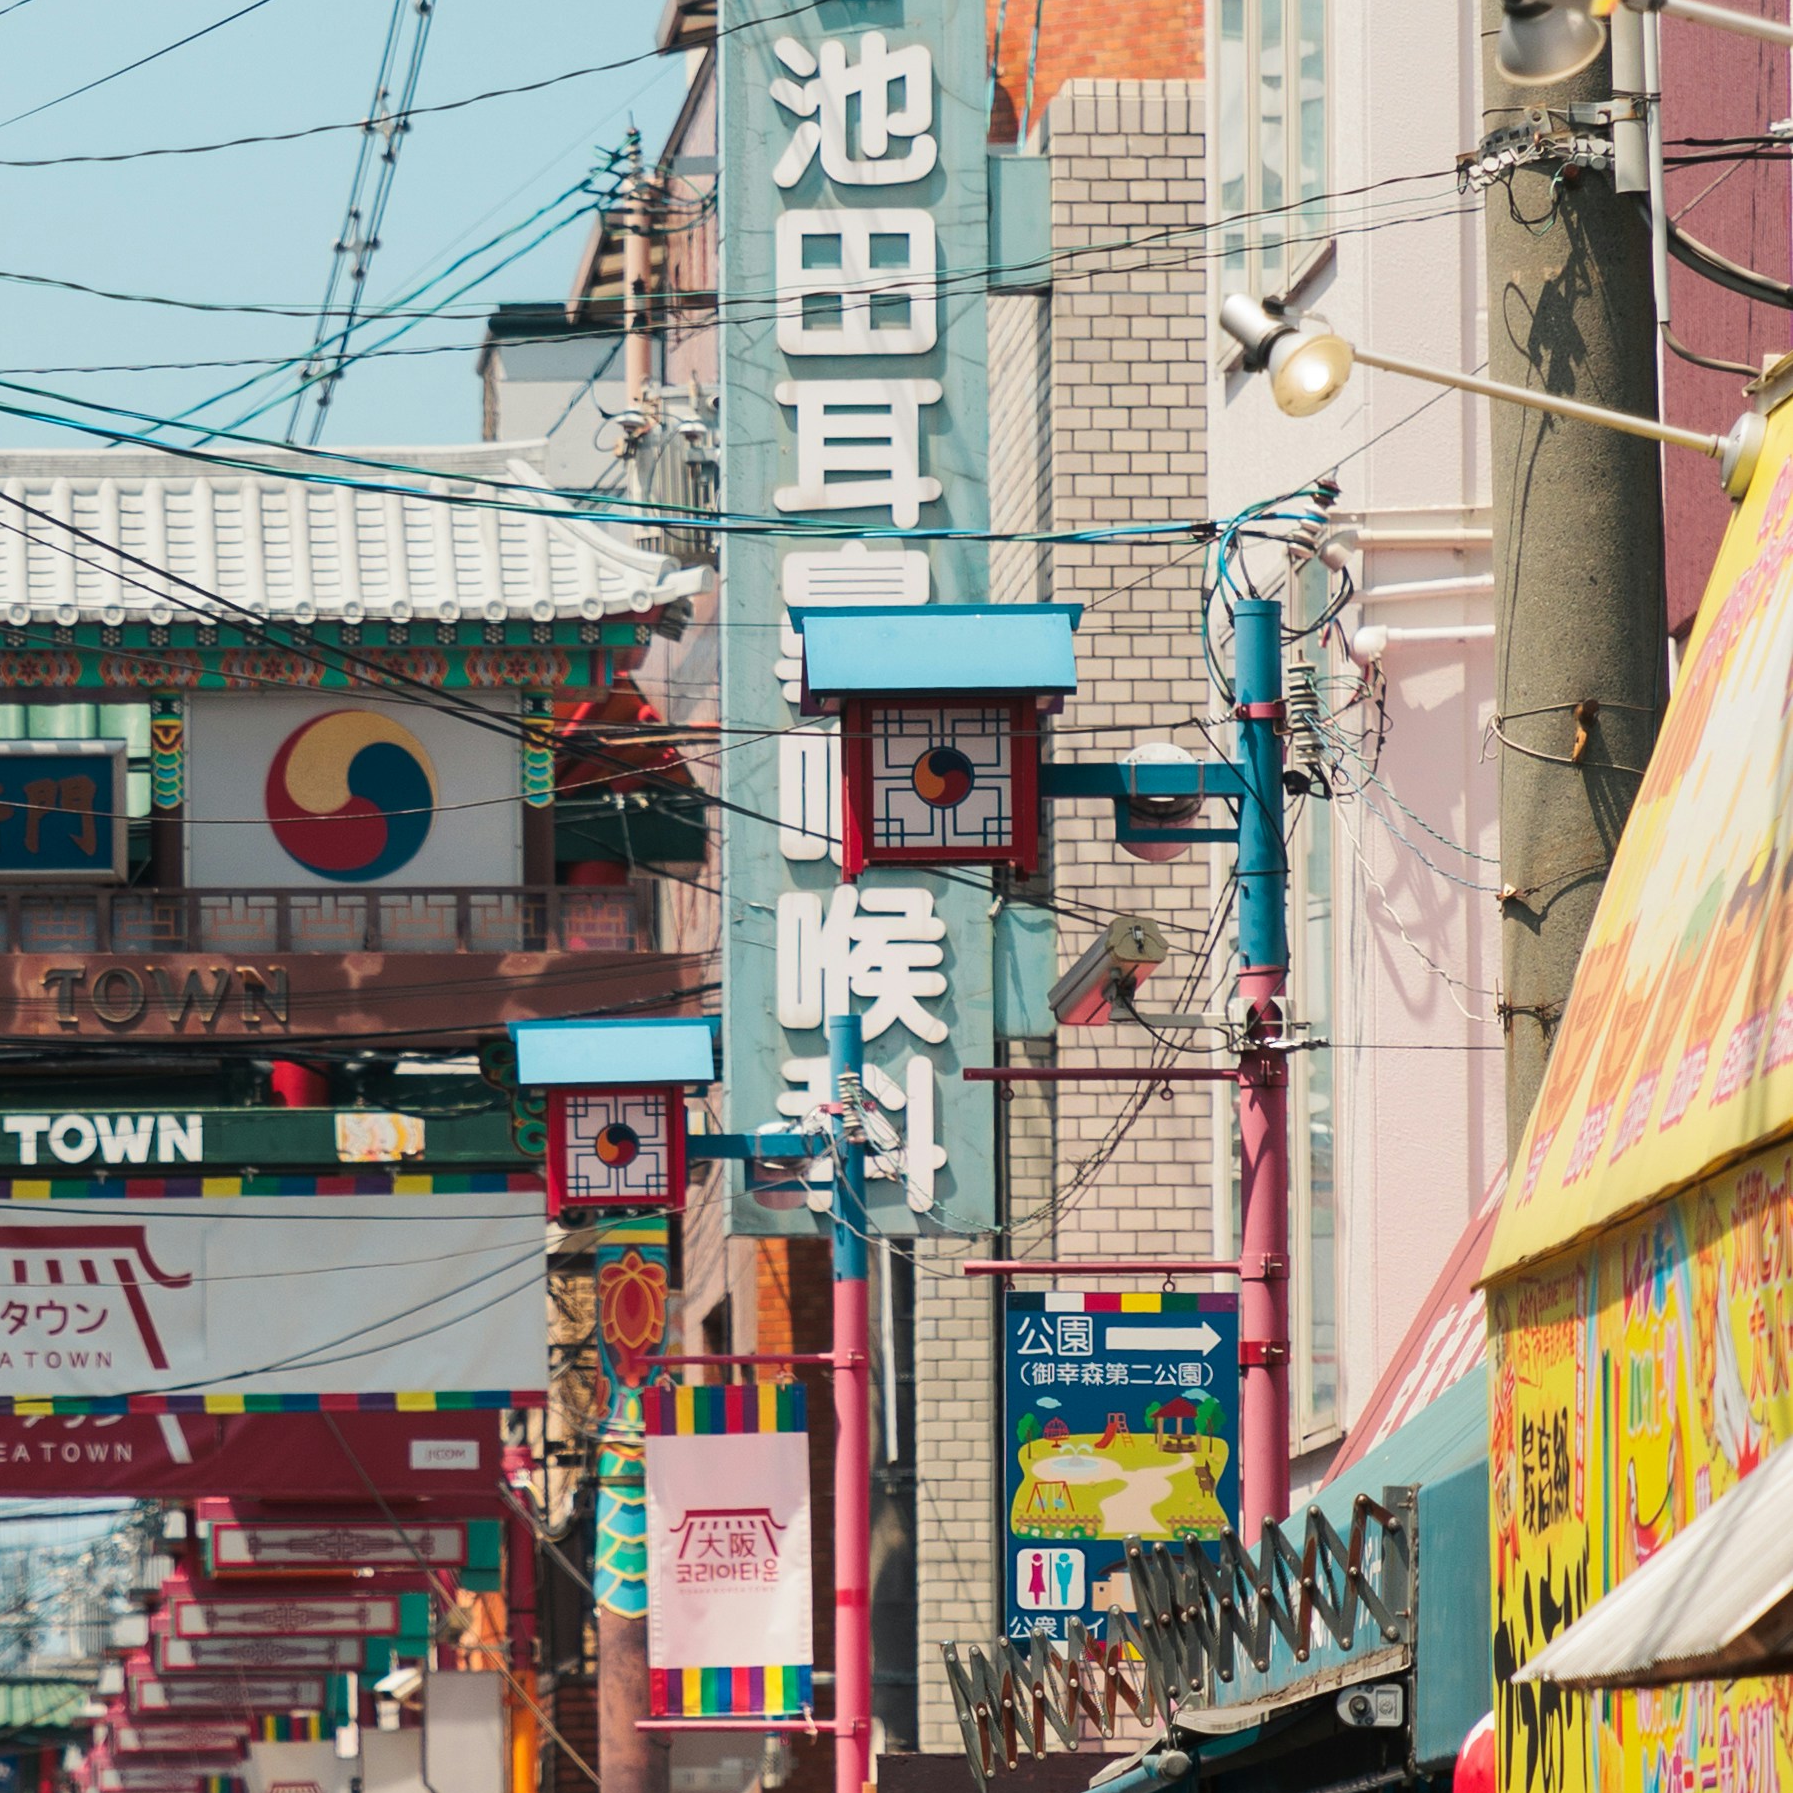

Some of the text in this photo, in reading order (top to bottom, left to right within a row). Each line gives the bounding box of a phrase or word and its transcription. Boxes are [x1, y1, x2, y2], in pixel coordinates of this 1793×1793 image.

[40, 964, 289, 1025] TOWN
[3, 1114, 204, 1164] TOWN
[1017, 1316, 1093, 1356] 公園
[24, 1351, 113, 1369] TOWN
[1020, 1362, 1214, 1387] (御幸森第二公園)
[41, 1443, 133, 1463] TOWN
[697, 1532, 757, 1558] 大阪
[676, 1558, 779, 1583] 코리아타운
[1010, 1616, 1104, 1639] 公衆トイ
